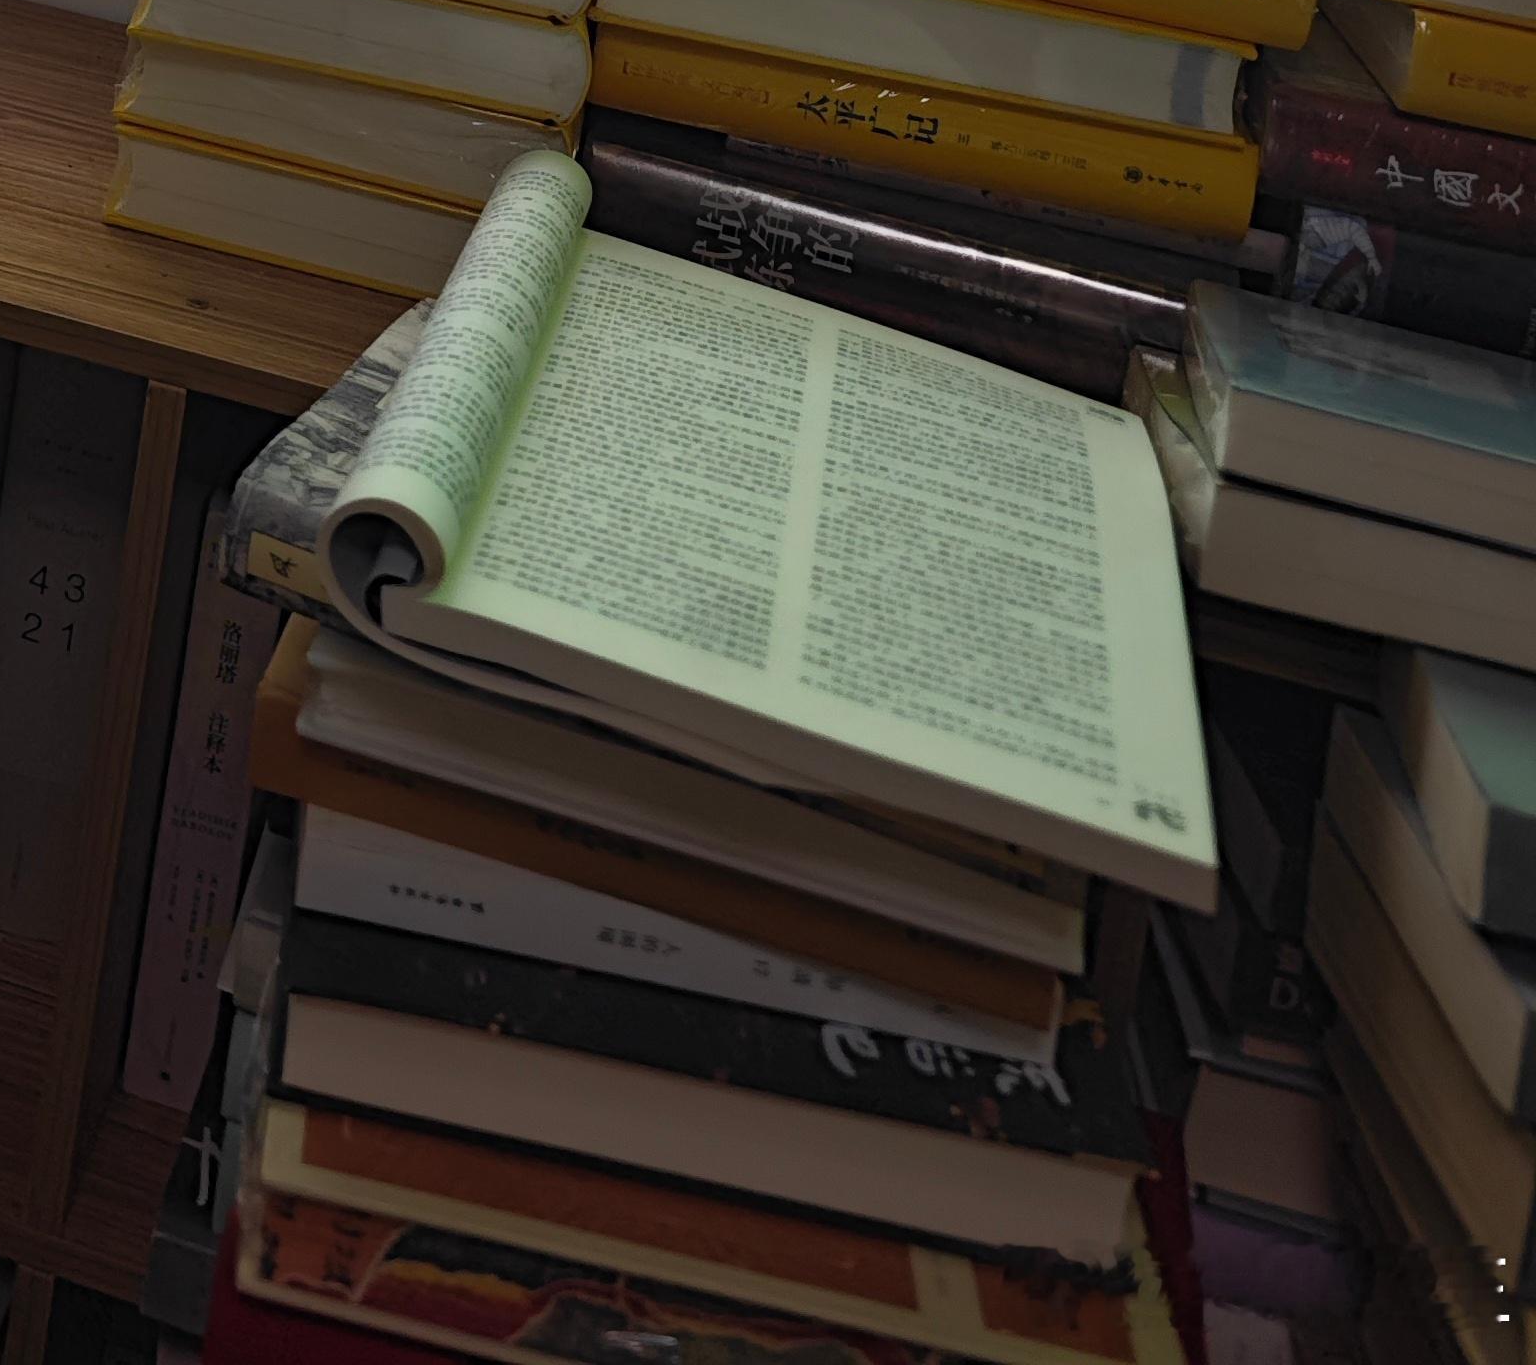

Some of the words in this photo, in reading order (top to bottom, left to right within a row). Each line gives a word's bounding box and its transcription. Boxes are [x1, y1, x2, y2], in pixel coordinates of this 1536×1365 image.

[796, 90, 940, 145] 太平广记
[695, 186, 861, 275] 战争的
[29, 565, 49, 595] 4
[64, 573, 87, 603] 3
[20, 612, 43, 644] 2
[61, 622, 75, 653] 1
[204, 712, 229, 775] 注释本
